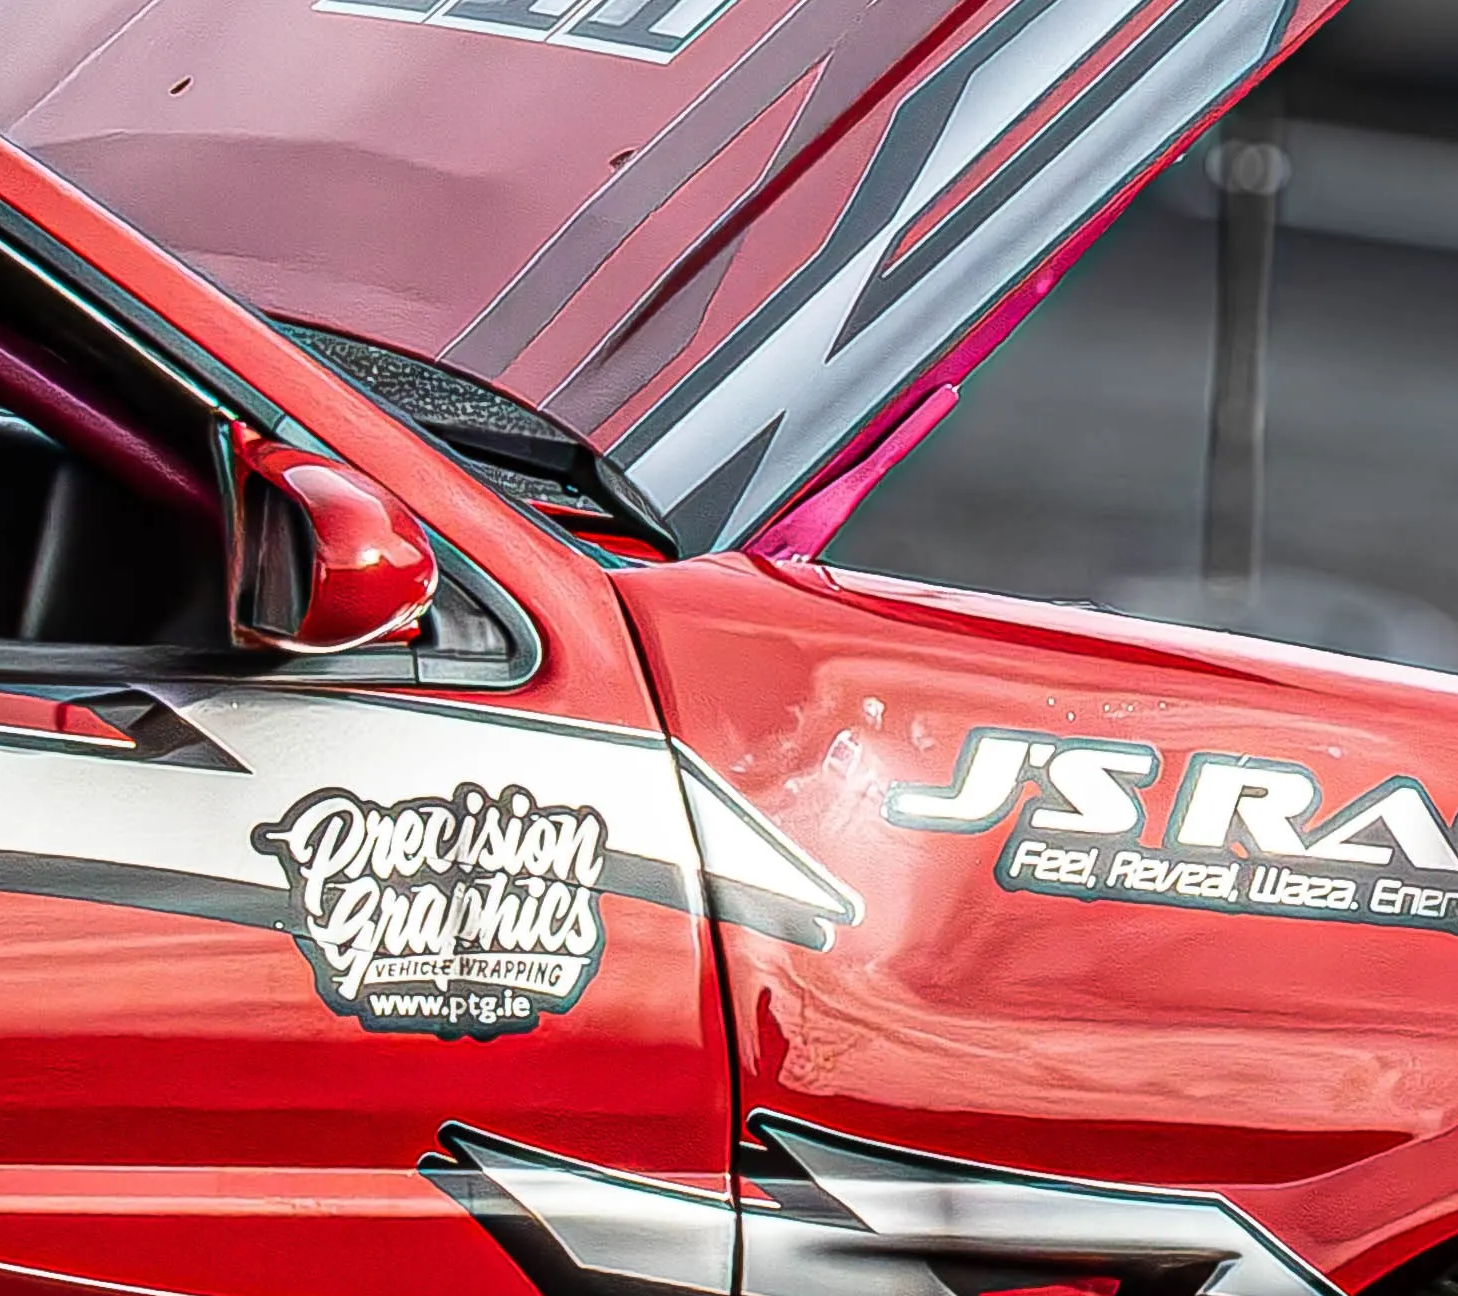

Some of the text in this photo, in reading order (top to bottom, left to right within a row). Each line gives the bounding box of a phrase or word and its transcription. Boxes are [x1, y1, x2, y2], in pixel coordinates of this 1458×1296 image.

[889, 735, 1154, 835] J'S
[264, 791, 605, 916] Precision
[306, 872, 599, 1000] Graphics
[375, 957, 563, 987] VEHICLE WRAPPING
[369, 988, 531, 1024] www.ptg.ie
